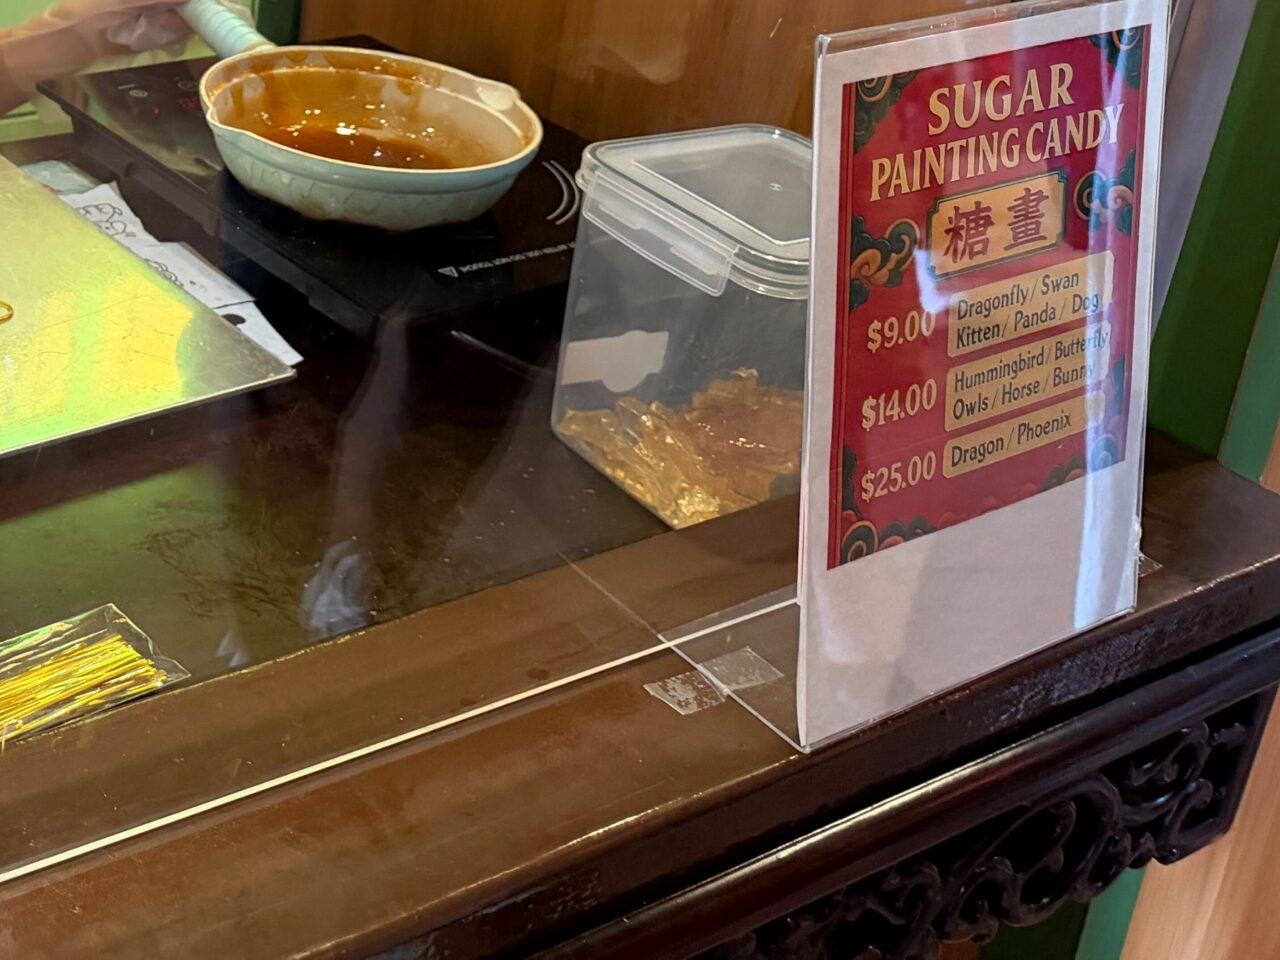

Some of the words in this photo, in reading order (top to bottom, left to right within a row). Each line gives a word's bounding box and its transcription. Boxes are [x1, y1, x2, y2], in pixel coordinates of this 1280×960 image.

[928, 62, 1075, 136] SUGAR
[869, 128, 1020, 202] PAINTING
[1025, 103, 1125, 163] CANDY
[942, 186, 1050, 264] 糖畫
[956, 322, 1000, 350] Kitten
[1014, 302, 1056, 332] Panda
[1072, 293, 1100, 314] Dog
[957, 283, 1030, 321] Dragonfly
[1041, 272, 1079, 296] Swan
[866, 310, 936, 354] $9.00
[954, 346, 1044, 393] Hummingbird
[1054, 327, 1109, 361] Butterfly
[861, 378, 937, 432] $14.00
[952, 393, 989, 420] Owls
[1001, 380, 1040, 405] Horse
[951, 436, 1004, 468] Dragon
[1017, 409, 1072, 445] Phoenix
[861, 451, 937, 503] $25.00
